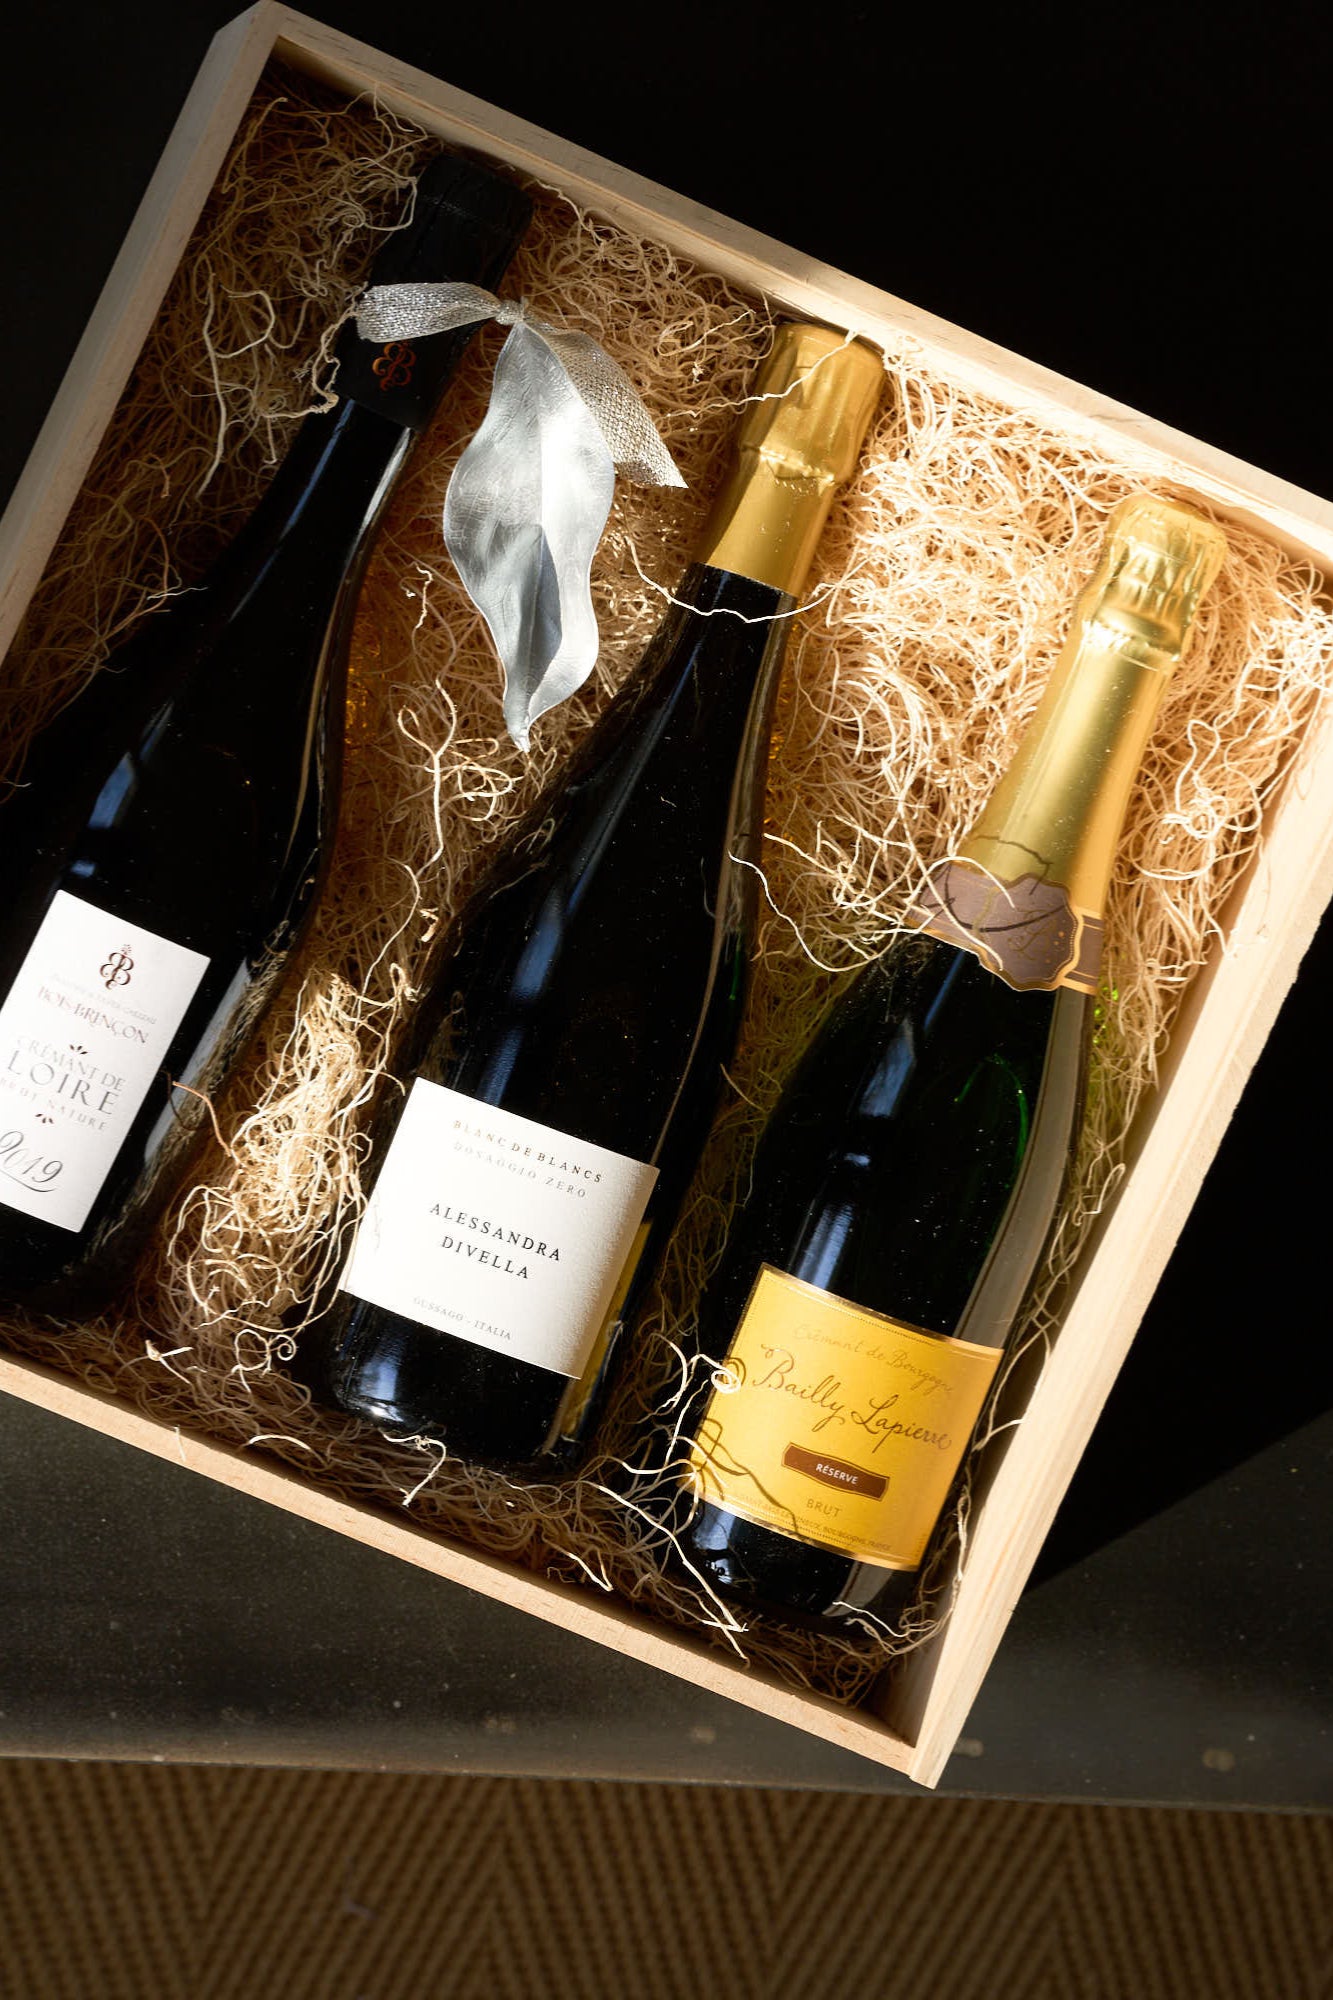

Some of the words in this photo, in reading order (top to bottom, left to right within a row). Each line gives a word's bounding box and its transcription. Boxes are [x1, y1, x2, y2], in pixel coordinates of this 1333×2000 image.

[8, 1050, 119, 1115] LOIRE
[101, 1073, 126, 1092] DE
[453, 1120, 506, 1147] BLANC
[511, 1142, 532, 1157] DE
[537, 1152, 602, 1183] BLANCS
[545, 1177, 587, 1199] ZERO
[429, 1203, 560, 1261] ALESSANDRA
[441, 1236, 528, 1280] DIVELLA
[414, 1297, 464, 1322] GUSSAGO
[474, 1319, 512, 1341] ITALIA
[793, 1324, 865, 1354] Crémant
[866, 1343, 886, 1361] de
[752, 1343, 846, 1433] Bailly
[850, 1393, 953, 1454] Lapierre
[815, 1463, 860, 1485] RÉSERVE
[805, 1498, 844, 1518] BRUT
